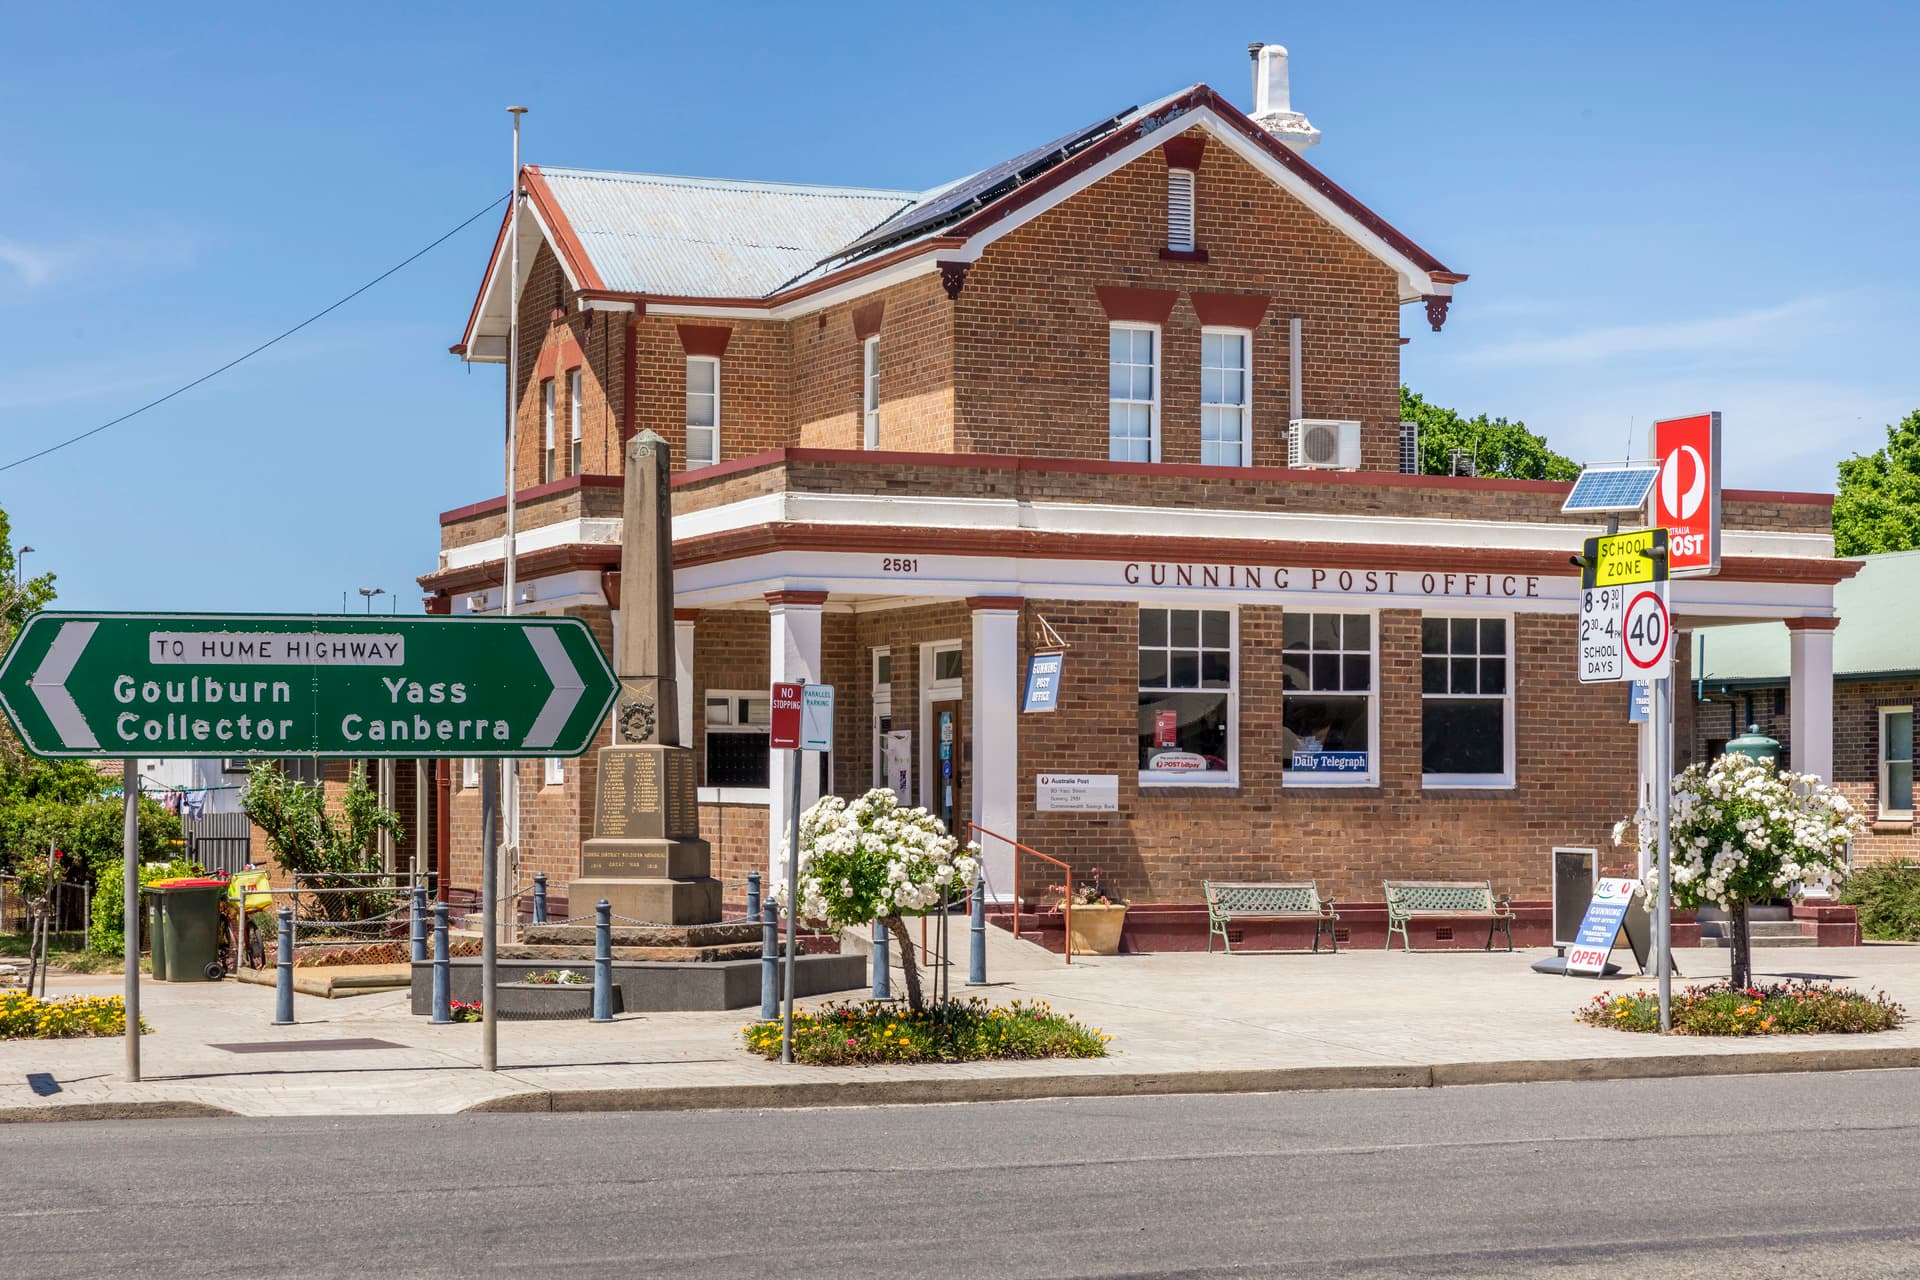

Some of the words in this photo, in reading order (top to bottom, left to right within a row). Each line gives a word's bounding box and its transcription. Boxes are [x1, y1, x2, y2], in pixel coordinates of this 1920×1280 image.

[1669, 526, 1690, 535] STRALIA
[883, 558, 917, 573] 2581
[1608, 560, 1641, 577] ZONE
[1124, 563, 1288, 589] GUNNING
[1312, 569, 1398, 593] POST
[1421, 574, 1539, 598] OFFICE
[1630, 612, 1660, 647] 40
[157, 640, 184, 657] TO
[202, 641, 271, 658] HUME
[287, 641, 399, 659] HIGHWAY
[1584, 645, 1618, 659] SCHOOL
[1588, 661, 1613, 674] DAYS
[114, 674, 290, 703] Goulburn
[382, 677, 467, 704] Yass
[781, 688, 794, 698] NO
[773, 699, 801, 710] STOPPING
[806, 699, 829, 707] PARKING
[116, 711, 293, 741] Collector
[341, 714, 510, 741] Canberra
[1294, 756, 1319, 769] Daily
[1321, 756, 1365, 770] Telegraph
[1591, 907, 1622, 917] GUNNING
[1572, 950, 1605, 966] OPEN
